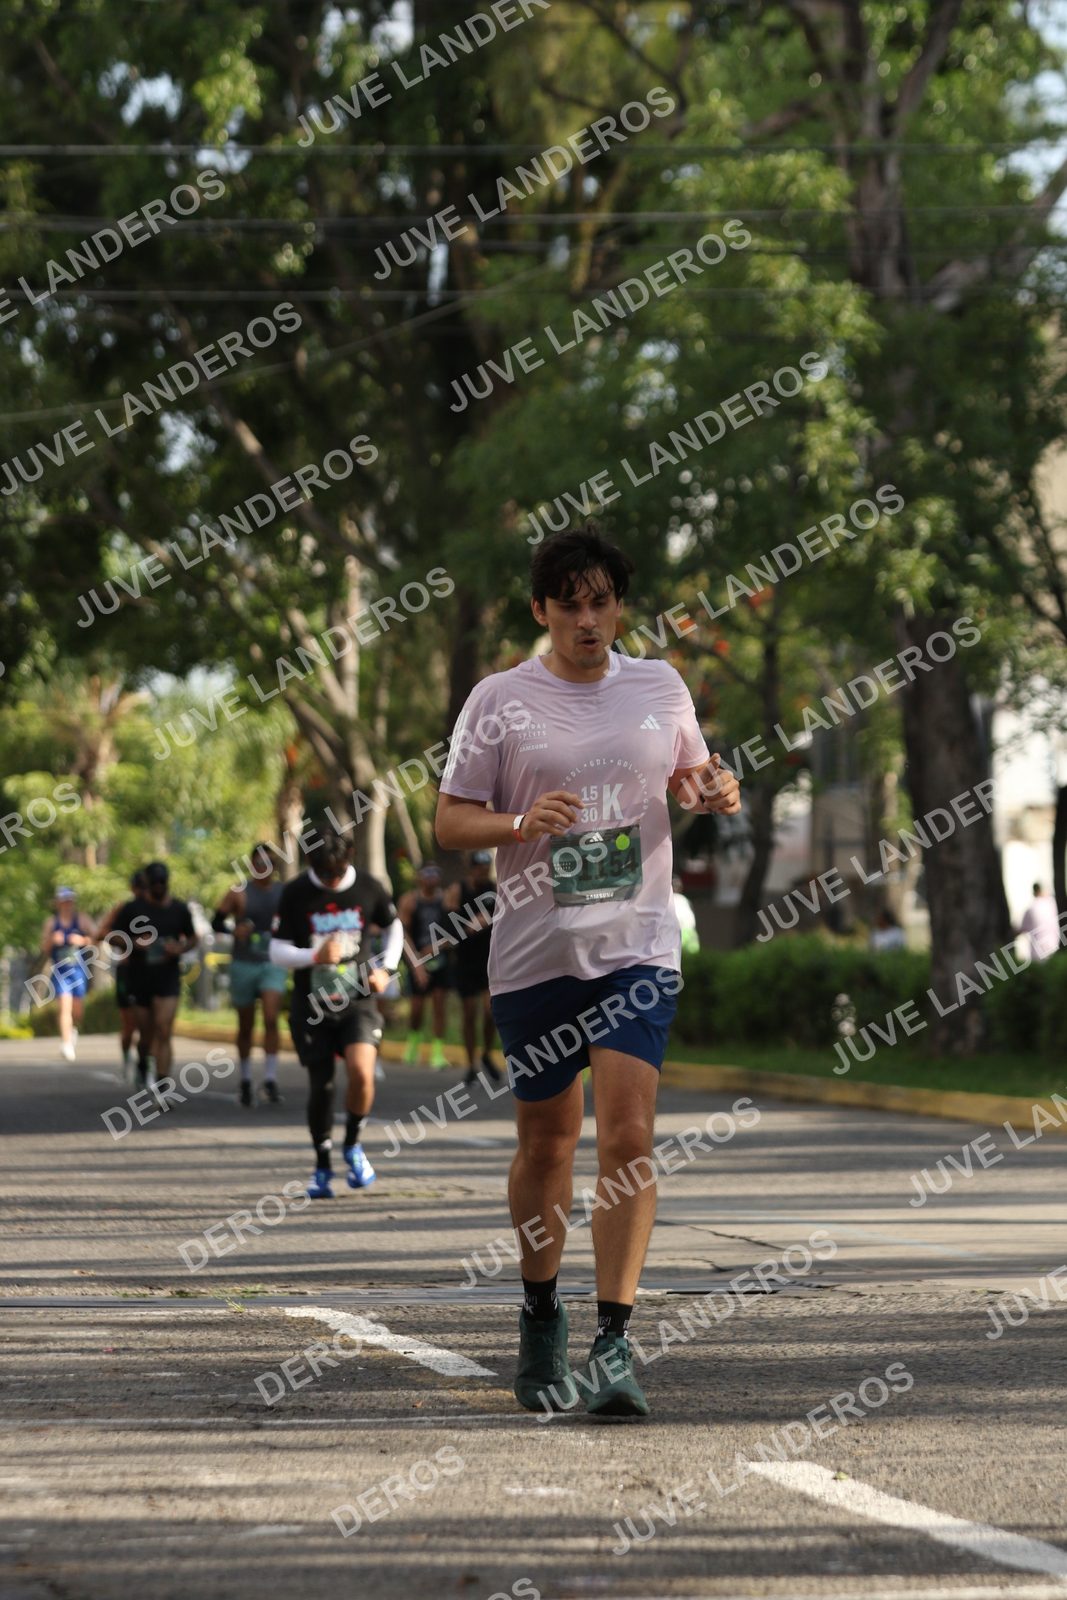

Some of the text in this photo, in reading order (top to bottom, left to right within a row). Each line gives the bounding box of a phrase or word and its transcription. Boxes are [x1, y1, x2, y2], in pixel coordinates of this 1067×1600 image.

[581, 785, 598, 802] 15
[602, 783, 624, 821] K
[581, 807, 598, 823] 30
[578, 846, 639, 881] 1154
